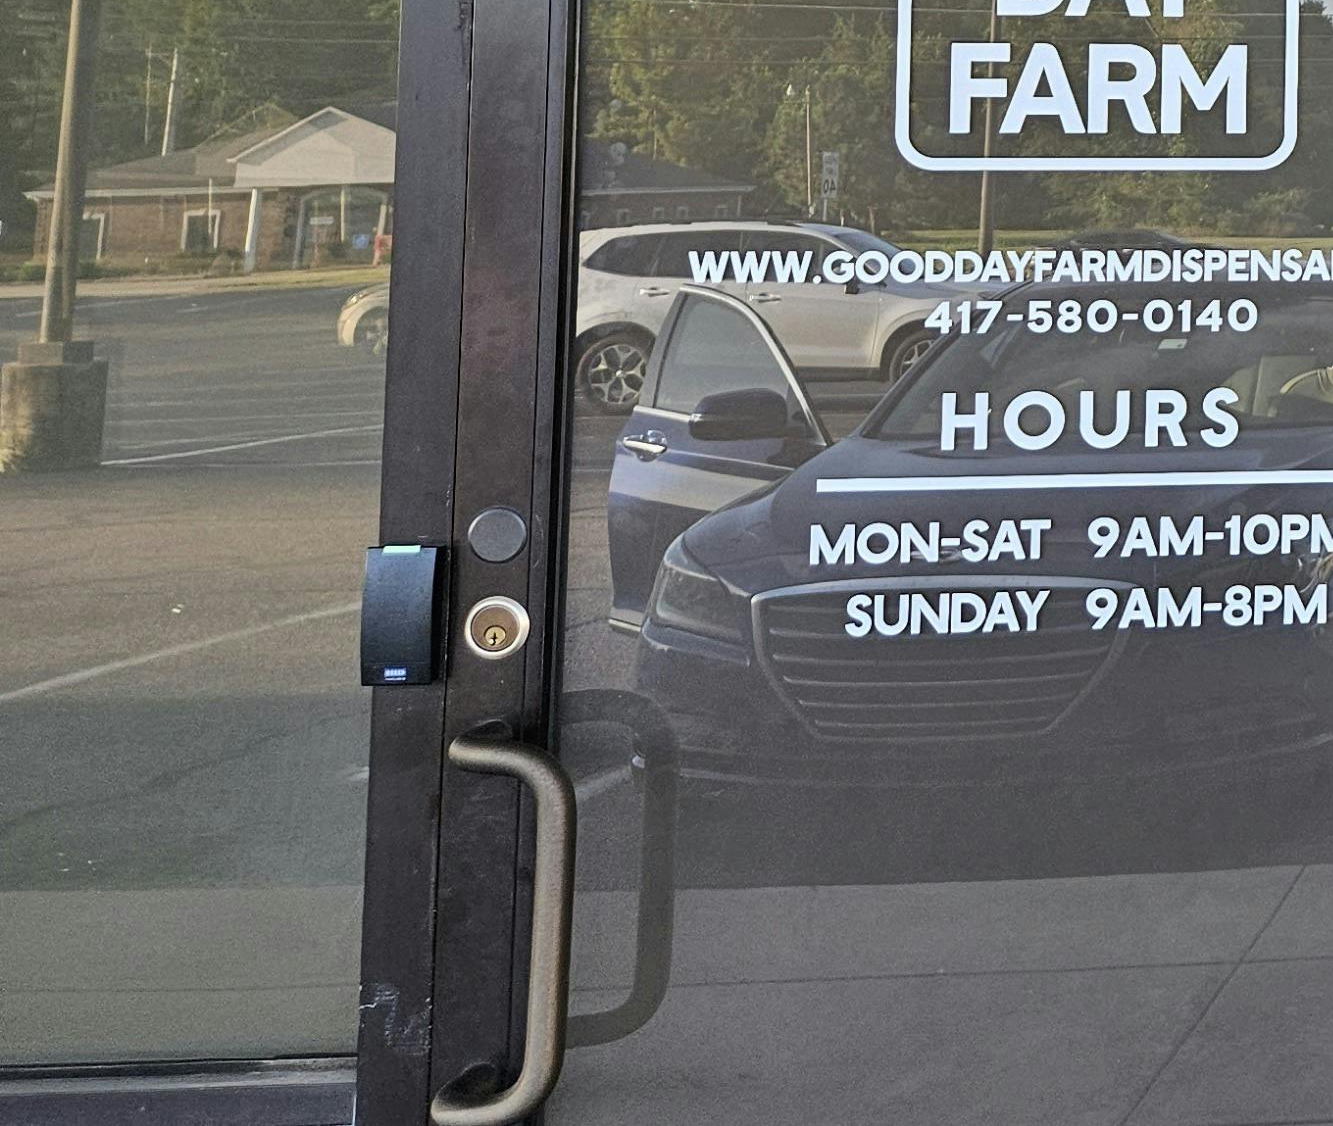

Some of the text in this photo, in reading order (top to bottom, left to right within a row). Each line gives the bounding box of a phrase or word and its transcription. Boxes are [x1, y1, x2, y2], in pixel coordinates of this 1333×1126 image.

[948, 42, 1247, 135] FARM
[923, 299, 1257, 334] 417-580-0140
[939, 388, 1241, 452] HOURS
[809, 518, 1052, 566] MON-SAT
[845, 584, 1328, 638] SUNDAY 9AM-8PM
